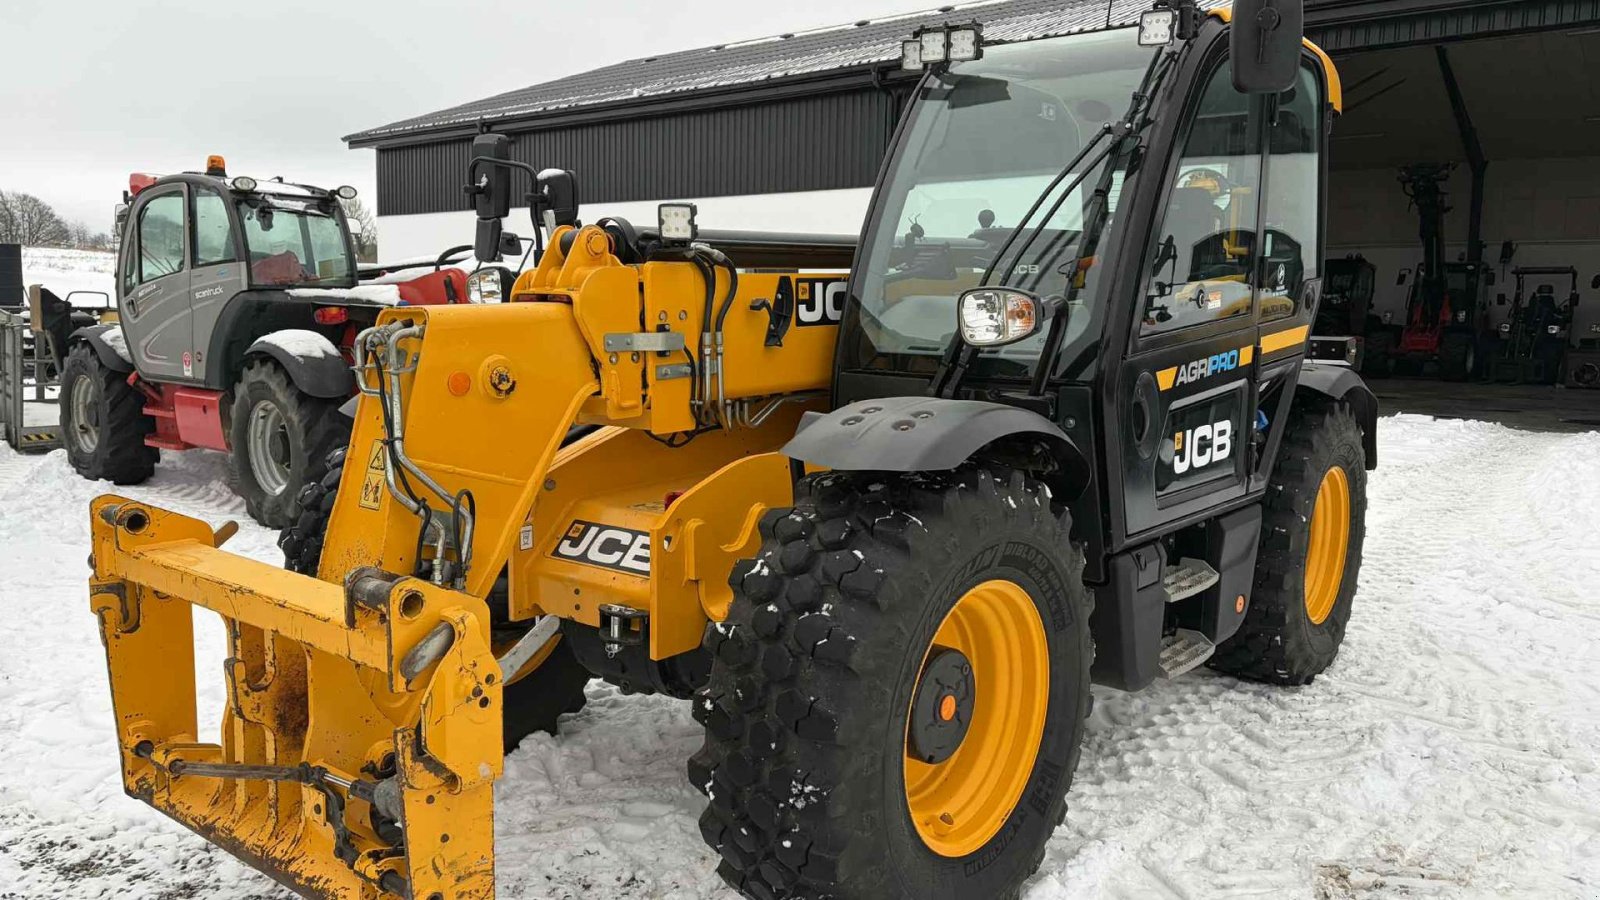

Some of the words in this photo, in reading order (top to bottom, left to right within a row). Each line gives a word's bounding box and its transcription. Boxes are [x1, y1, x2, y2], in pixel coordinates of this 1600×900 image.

[195, 285, 223, 299] scantruck
[798, 281, 848, 322] JC
[1176, 350, 1238, 387] AGRIPRO
[1174, 420, 1231, 474] JCB
[558, 526, 651, 571] JCB
